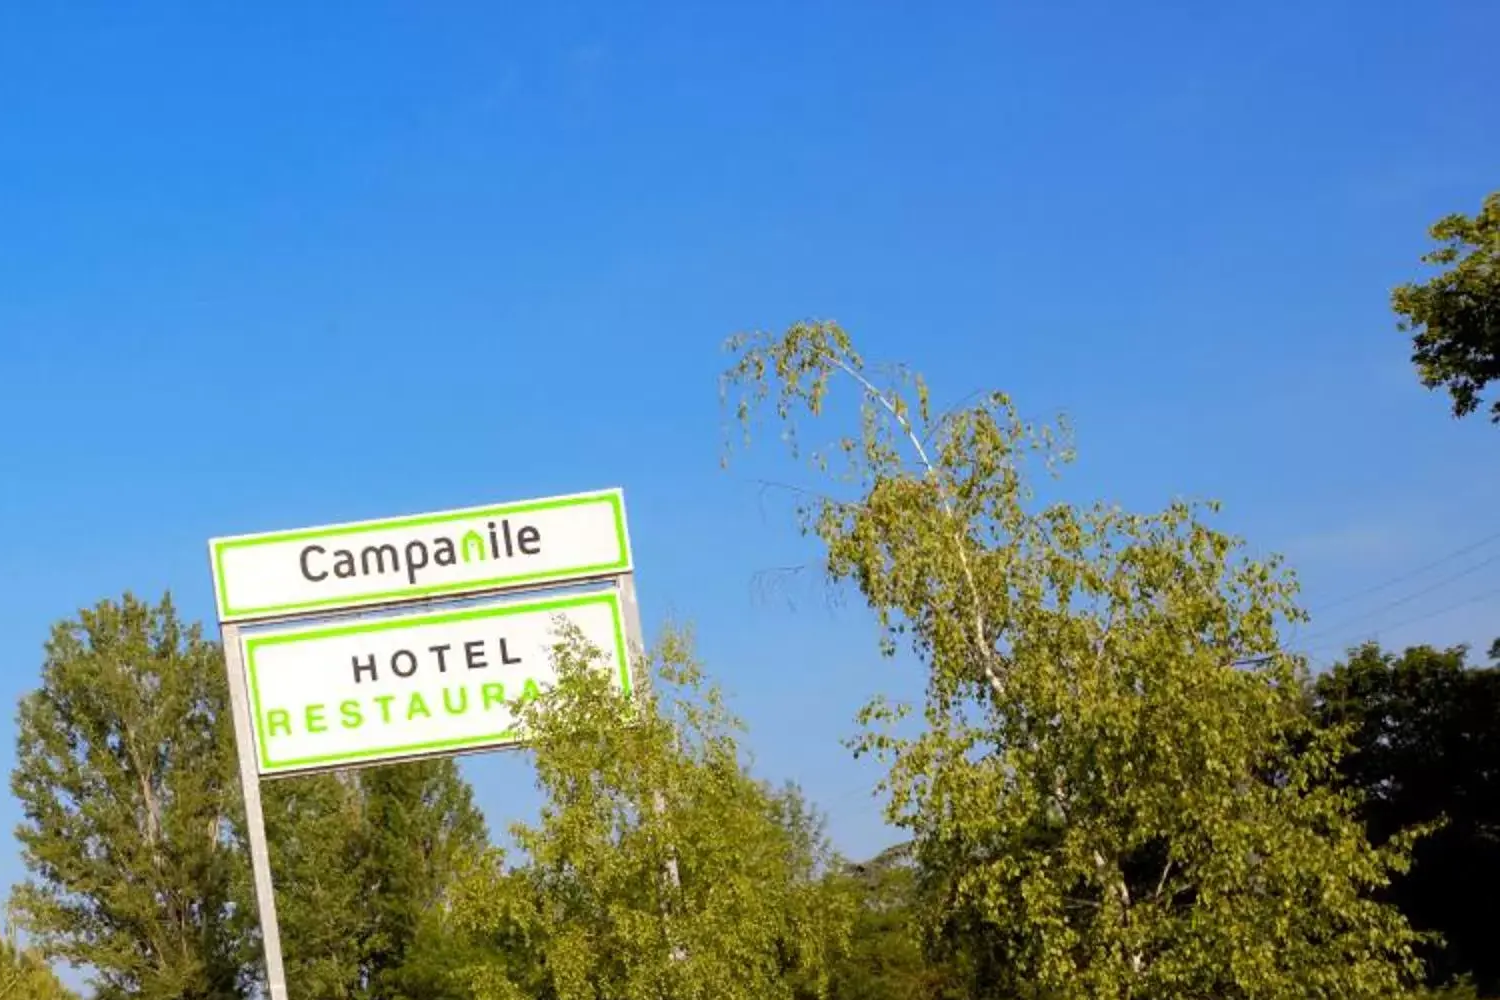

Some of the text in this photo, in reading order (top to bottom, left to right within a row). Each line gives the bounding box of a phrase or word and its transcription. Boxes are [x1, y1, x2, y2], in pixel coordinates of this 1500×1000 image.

[300, 519, 541, 584] Campanile
[352, 637, 522, 682] HOTEL
[266, 678, 541, 736] RESTAURA
